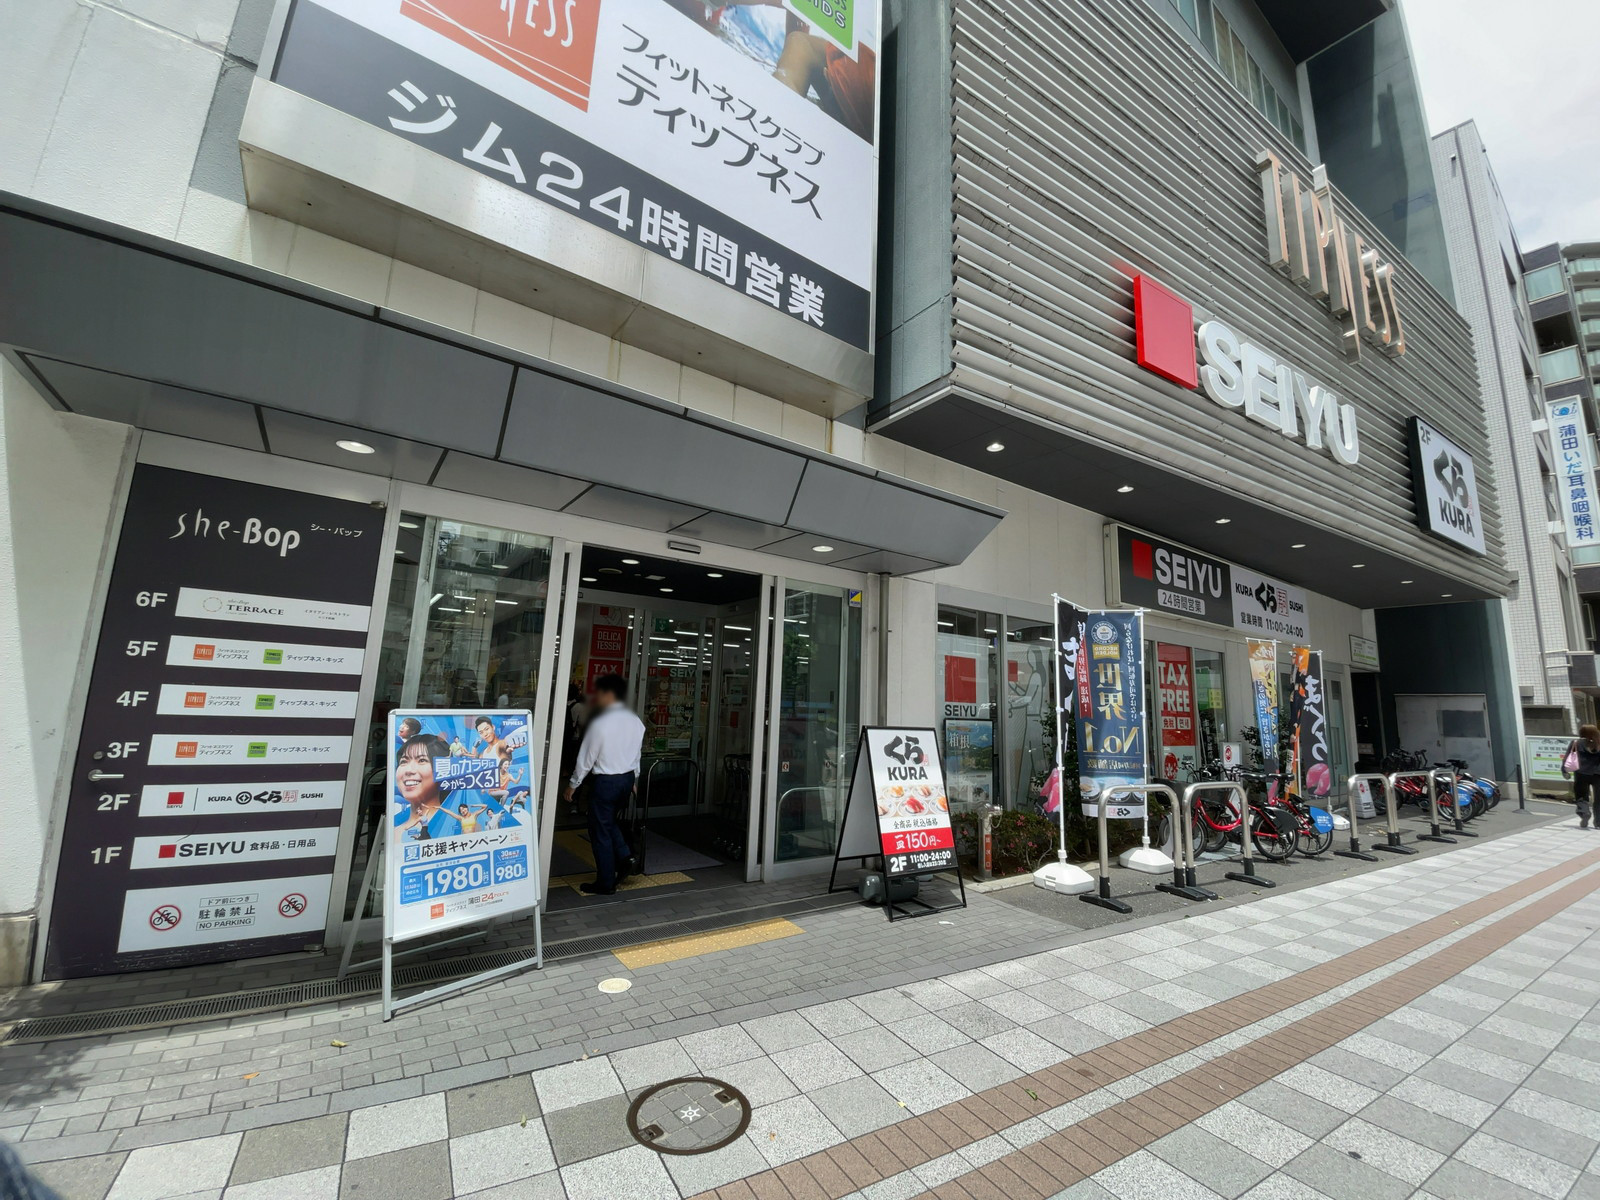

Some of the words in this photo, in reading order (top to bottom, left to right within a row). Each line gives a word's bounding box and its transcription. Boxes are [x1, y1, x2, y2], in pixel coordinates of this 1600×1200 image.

[618, 22, 828, 167] フィットネスクラブ
[615, 63, 825, 222] ティップネス
[386, 79, 827, 329] ジム24時間営業
[1197, 320, 1360, 466] SEIYU
[1419, 425, 1433, 446] 2F
[1432, 448, 1470, 510] くら
[1557, 423, 1595, 540] 蒲田いだ耳鼻咽喉科
[1438, 496, 1476, 538] KURA
[168, 507, 301, 557] she-Bop
[309, 522, 363, 538] シー・バップ
[1154, 547, 1223, 599] SEIYU
[135, 591, 168, 608] 6F
[1161, 591, 1203, 614] 24時間営業
[1234, 582, 1254, 598] KURA
[1254, 581, 1278, 614] くら
[1288, 599, 1305, 614] SUSHI
[226, 604, 285, 616] TERRACE
[1240, 611, 1263, 629] 営業時間
[1265, 617, 1304, 639] 11:00-24:00
[597, 630, 622, 642] DELICA
[125, 640, 158, 657] 5F
[597, 640, 622, 651] TESSEN
[216, 652, 249, 660] ティップネス
[286, 654, 344, 664] ティップネス・キッズ
[594, 663, 618, 674] TAX
[1157, 661, 1189, 687] TAX
[116, 690, 149, 707] 4F
[207, 699, 241, 707] ティップネス
[278, 699, 338, 708] ティップネス・キッズ
[1161, 688, 1191, 713] FREE
[944, 704, 977, 717] SEIYU
[106, 741, 140, 759] 3F
[271, 745, 331, 754] ティップネス・キッズ
[883, 734, 925, 766] くら
[435, 758, 496, 780] 夏のカラダは
[886, 765, 929, 781] KURA
[439, 767, 500, 791] 今からつくる!
[97, 793, 131, 811] 2F
[207, 795, 233, 803] KURA
[253, 790, 283, 804] くら
[300, 792, 324, 800] SUSHI
[893, 819, 912, 830] 全商品
[912, 817, 939, 829] 税込価格
[90, 846, 122, 865] 1F
[178, 840, 246, 858] SEIYU
[249, 838, 317, 852] 食料品・日用品
[404, 833, 509, 863] 夏応援キャンペーン
[889, 855, 908, 873] 2F
[909, 849, 952, 864] 11:00-24:00
[206, 895, 251, 905] ドア前につき
[197, 905, 257, 920] 駐輪禁止
[198, 921, 213, 930] NO
[213, 917, 252, 928] PARKING
